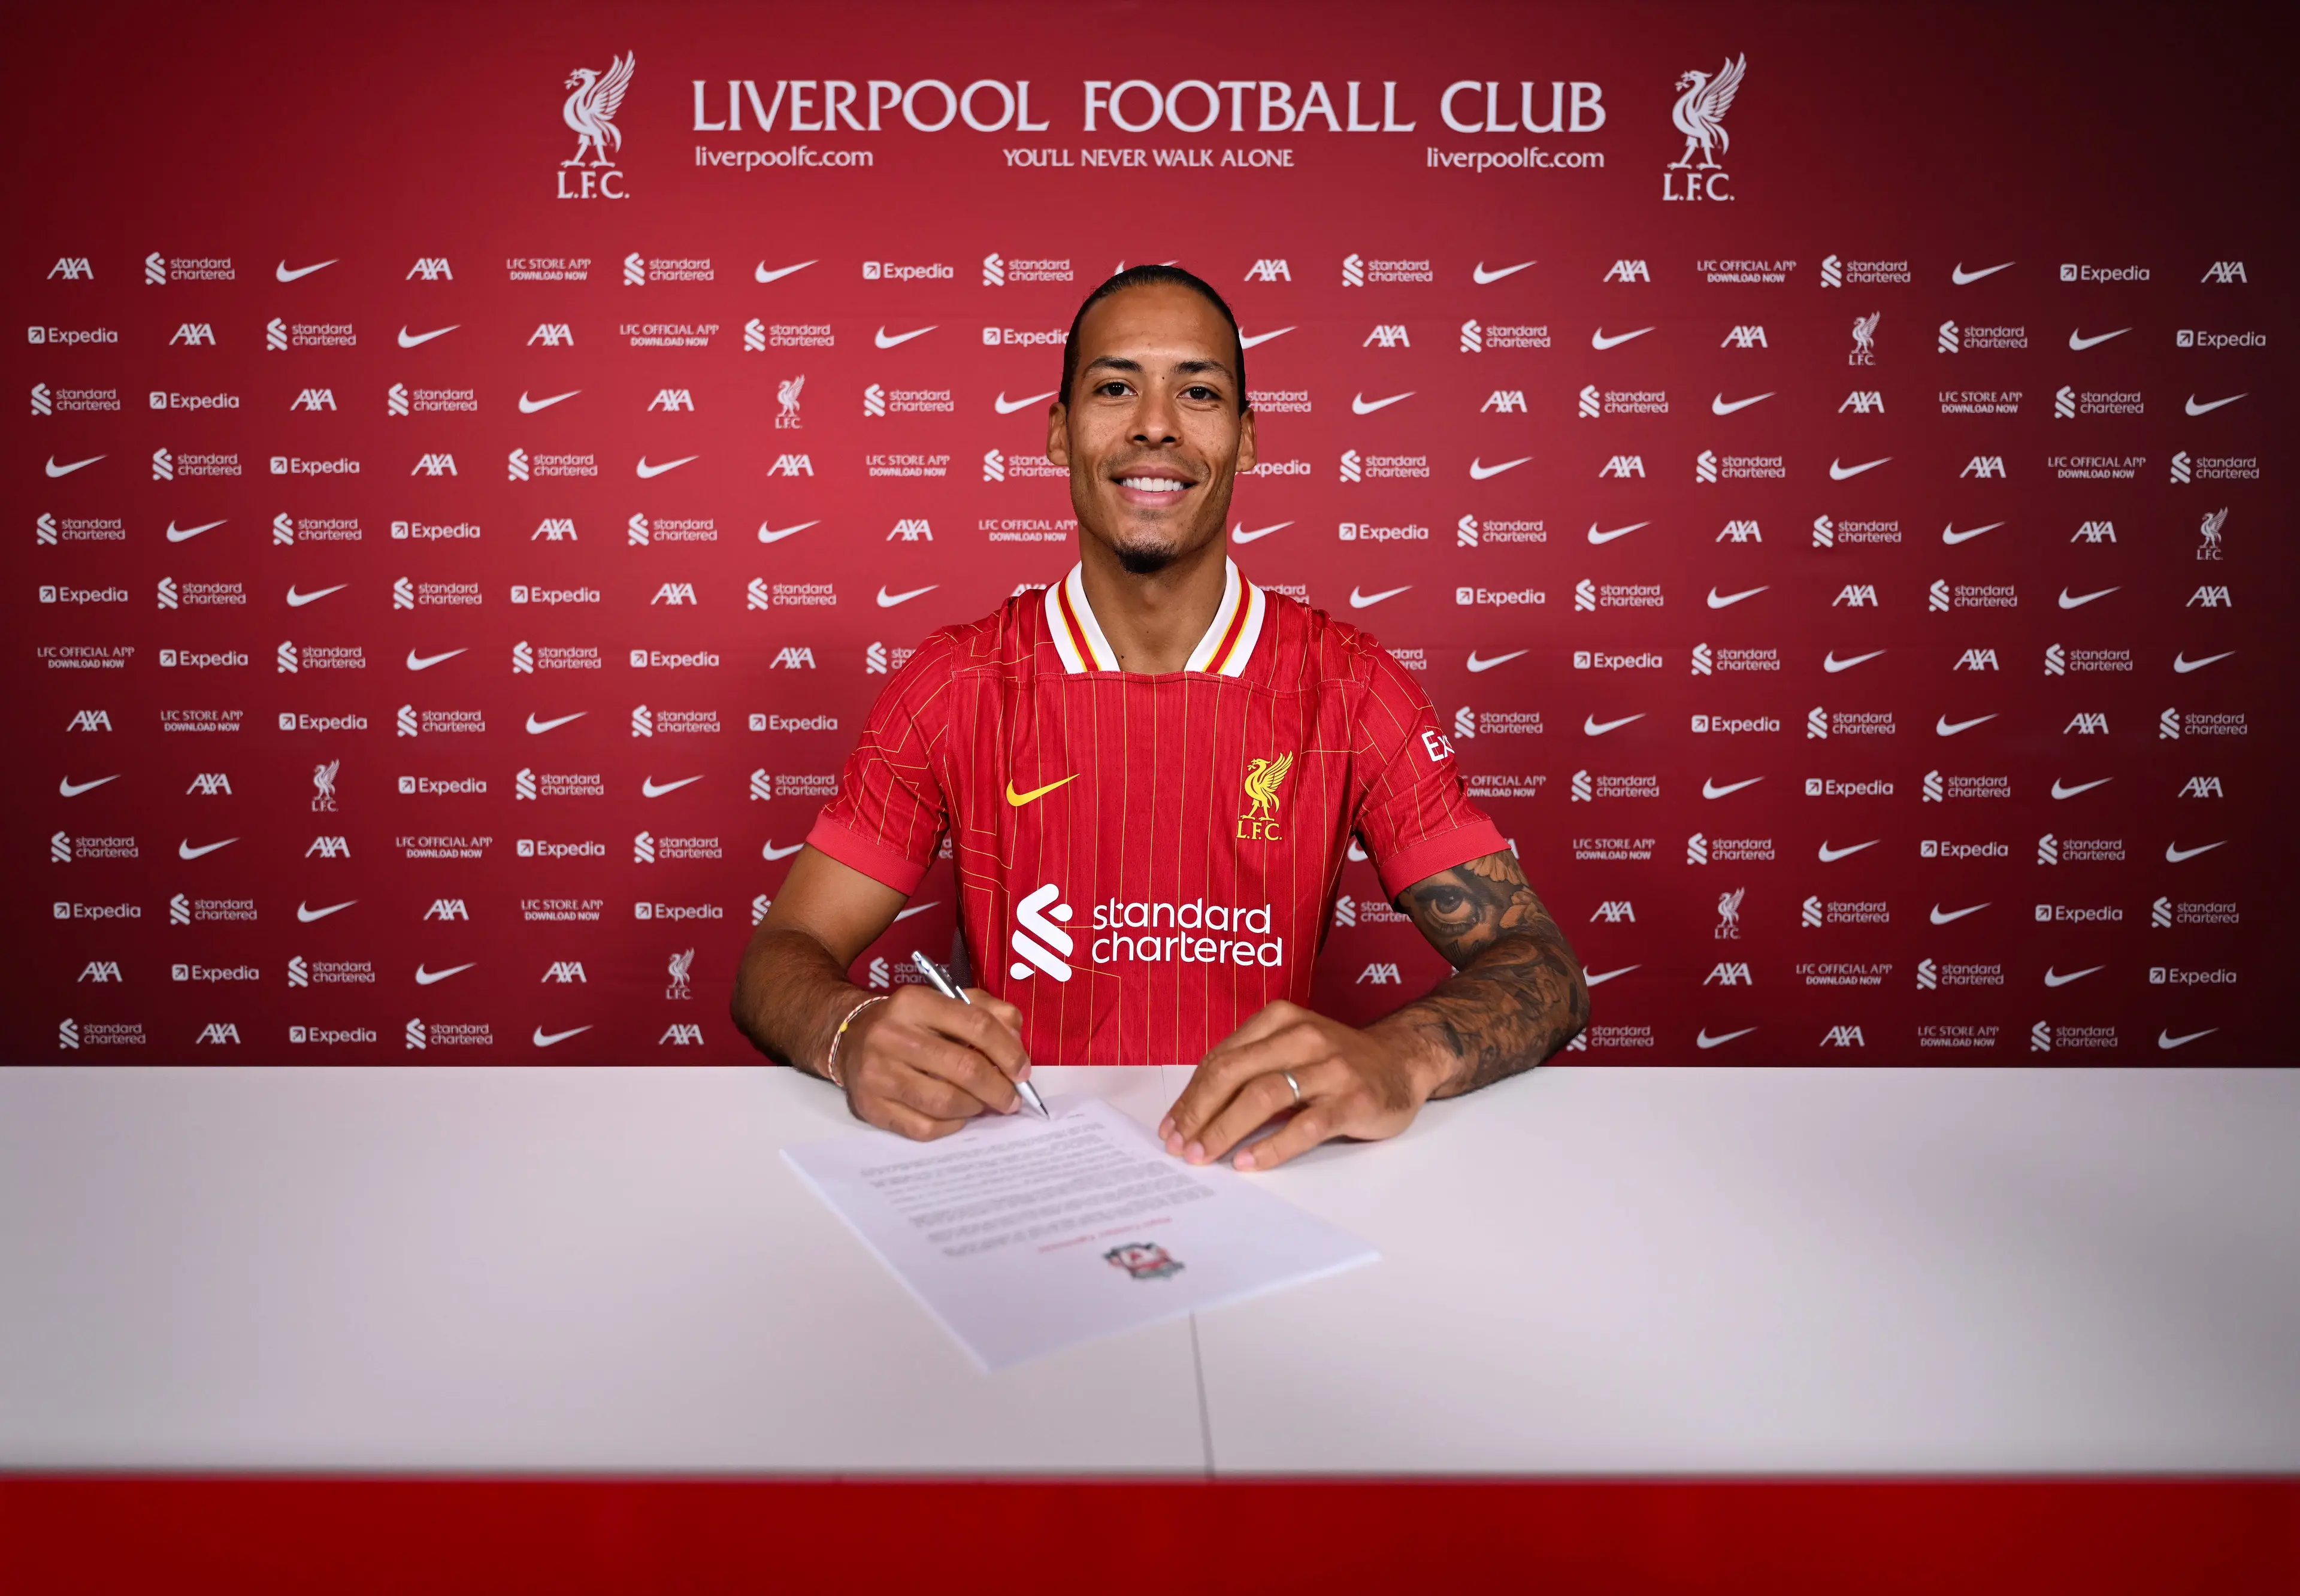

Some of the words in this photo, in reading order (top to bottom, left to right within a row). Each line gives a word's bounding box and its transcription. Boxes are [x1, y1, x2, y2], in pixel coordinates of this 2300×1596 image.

[692, 80, 1049, 132] LIVERPOOL
[1084, 80, 1416, 132] FOOTBALL
[1441, 81, 1606, 133] CLUB
[696, 146, 873, 171] liverpoolfc.com
[1003, 149, 1075, 166] YOU'LL
[1081, 149, 1148, 166] NEVER
[1152, 149, 1214, 166] WALK
[1220, 149, 1294, 166] ALONE
[1427, 147, 1604, 172] liverpoolfc.com
[558, 171, 630, 199] L.F.C.
[1663, 173, 1735, 201] L.F.C.
[47, 257, 94, 280] AXA
[170, 258, 231, 270] standard
[405, 258, 453, 281] AXA
[506, 258, 526, 269] LFC
[528, 258, 567, 269] STORE
[568, 258, 592, 269] APP
[883, 262, 954, 282] Expedia
[1008, 259, 1069, 271] standard
[1243, 259, 1292, 282] AXA
[1368, 259, 1429, 272] standard
[1603, 259, 1651, 283] AXA
[1697, 260, 1717, 271] LFC
[1719, 260, 1771, 272] OFFICIAL
[1773, 260, 1797, 271] APP
[1847, 261, 1908, 273] standard
[2201, 261, 2248, 283] AXA
[170, 268, 235, 280] chartered
[510, 271, 564, 281] DOWNLOAD
[564, 271, 588, 281] NOW
[1008, 269, 1074, 281] chartered
[1367, 270, 1433, 282] chartered
[1707, 272, 1761, 283] DOWNLOAD
[1762, 273, 1785, 283] NOW
[1846, 271, 1911, 283] chartered
[2080, 265, 2150, 284] Expedia
[48, 327, 119, 346] Expedia
[168, 323, 216, 346] AXA
[526, 323, 574, 346] AXA
[770, 324, 831, 337] standard
[1362, 325, 1411, 348] AXA
[1486, 325, 1547, 338] standard
[1720, 325, 1768, 349] AXA
[769, 335, 835, 347] chartered
[1485, 336, 1551, 348] chartered
[2197, 331, 2266, 350] Expedia
[56, 388, 117, 401] standard
[170, 392, 240, 411] Expedia
[290, 388, 337, 411] AXA
[647, 389, 695, 412] AXA
[1480, 390, 1528, 413] AXA
[1838, 390, 1885, 414] AXA
[56, 399, 121, 411] chartered
[290, 458, 360, 477] Expedia
[411, 453, 458, 476] AXA
[534, 454, 594, 467] standard
[767, 453, 815, 477] AXA
[1598, 455, 1646, 478] AXA
[1959, 456, 2007, 479] AXA
[2196, 457, 2256, 468] standard
[533, 465, 598, 477] chartered
[2196, 468, 2260, 479] chartered
[298, 518, 359, 531] standard
[411, 522, 481, 541] Expedia
[531, 518, 578, 541] AXA
[886, 519, 934, 541] AXA
[1359, 523, 1429, 543] Expedia
[1715, 520, 1762, 543] AXA
[2070, 520, 2117, 543] AXA
[298, 529, 362, 541] chartered
[59, 586, 129, 605] Expedia
[419, 583, 479, 595] standard
[531, 586, 600, 605] Expedia
[650, 583, 698, 605] AXA
[1476, 587, 1546, 607] Expedia
[1832, 584, 1878, 607] AXA
[1954, 585, 2014, 597] standard
[2186, 585, 2232, 607] AXA
[418, 593, 482, 605] chartered
[1954, 595, 2018, 607] chartered
[37, 647, 57, 658] LFC
[59, 646, 110, 658] OFFICIAL
[112, 646, 135, 658] APP
[180, 650, 249, 669] Expedia
[650, 650, 719, 670] Expedia
[769, 647, 816, 669] AXA
[1594, 652, 1663, 671] Expedia
[1953, 649, 1999, 671] AXA
[2070, 649, 2130, 661] standard
[48, 659, 101, 669] DOWNLOAD
[102, 659, 125, 668] NOW
[2069, 659, 2133, 671] chartered
[66, 710, 113, 732] AXA
[299, 713, 368, 732] Expedia
[657, 710, 717, 723] standard
[768, 714, 838, 733] Expedia
[1711, 716, 1780, 735] Expedia
[1833, 712, 1892, 725] standard
[2063, 712, 2109, 735] AXA
[656, 721, 721, 733] chartered
[1832, 723, 1896, 734] chartered
[186, 773, 232, 795] AXA
[418, 777, 487, 796] Expedia
[1825, 779, 1894, 798] Expedia
[2177, 776, 2223, 798] AXA
[1236, 820, 1282, 841] L.F.C.
[75, 836, 135, 849] standard
[305, 835, 351, 858] AXA
[537, 840, 606, 859] Expedia
[1573, 838, 1592, 849] LFC
[1594, 838, 1630, 850] STORE
[1633, 838, 1656, 849] APP
[1712, 838, 1774, 851] standard
[1941, 841, 2009, 860] Expedia
[75, 847, 139, 858] chartered
[1576, 850, 1629, 860] DOWNLOAD
[1629, 850, 1651, 860] NOW
[1712, 849, 1775, 861] chartered
[73, 903, 141, 921] Expedia
[195, 899, 253, 911] standard
[195, 909, 258, 920] chartered
[423, 898, 470, 921] AXA
[654, 903, 724, 922] Expedia
[1590, 901, 1636, 923] AXA
[1827, 901, 1886, 913] standard
[2055, 905, 2123, 923] Expedia
[2177, 902, 2236, 914] standard
[1092, 897, 1271, 934] standard
[1826, 911, 1890, 923] chartered
[2176, 913, 2240, 923] chartered
[1091, 931, 1282, 967] chartered
[77, 961, 123, 983] AXA
[191, 965, 260, 983] Expedia
[541, 961, 587, 983] AXA
[1355, 963, 1402, 985] AXA
[1703, 962, 1753, 986] AXA
[1941, 974, 2004, 985] chartered
[1942, 964, 2001, 976] standard
[2169, 968, 2237, 986] Expedia
[195, 1023, 241, 1044] AXA
[309, 1026, 377, 1045] Expedia
[431, 1023, 489, 1035] standard
[658, 1023, 704, 1046] AXA
[1819, 1025, 1865, 1047] AXA
[431, 1034, 493, 1045] chartered
